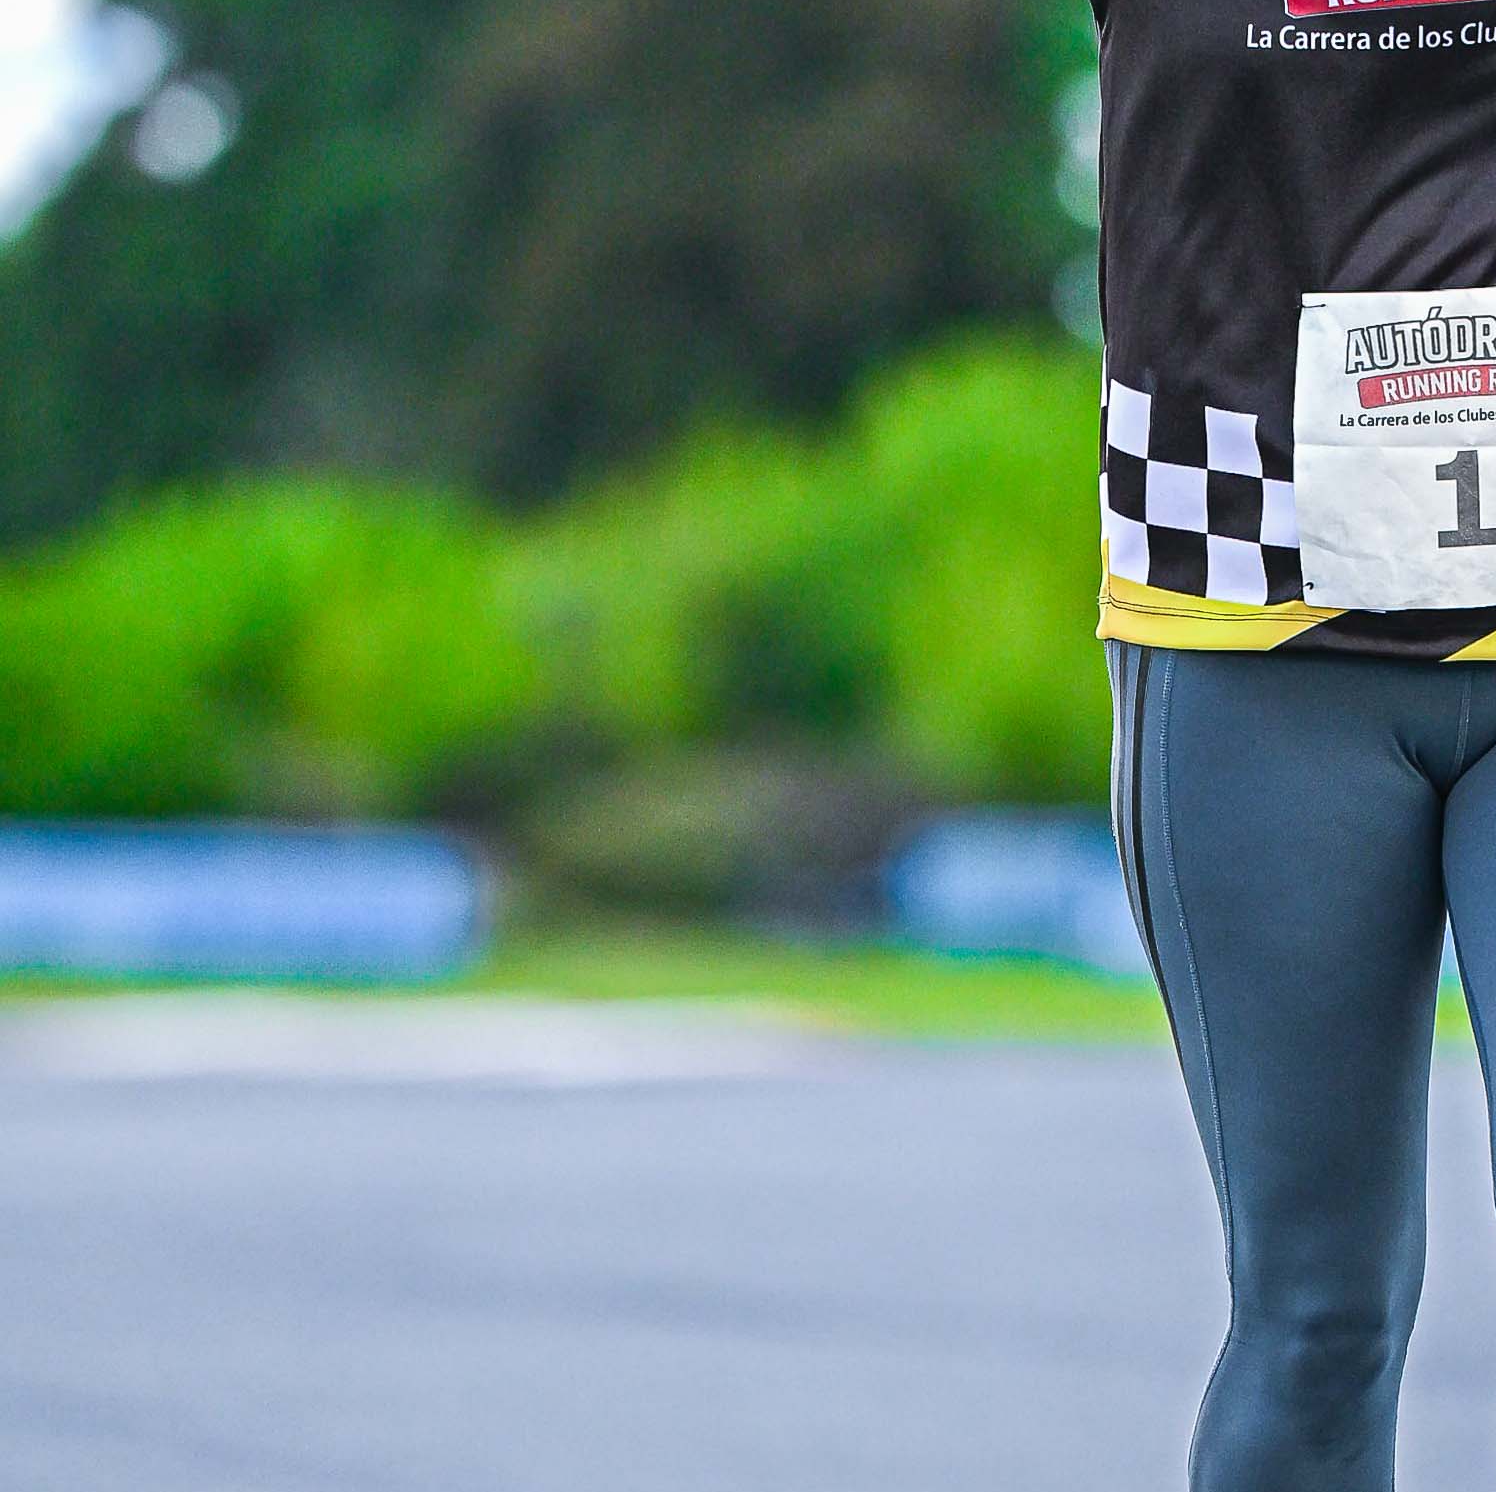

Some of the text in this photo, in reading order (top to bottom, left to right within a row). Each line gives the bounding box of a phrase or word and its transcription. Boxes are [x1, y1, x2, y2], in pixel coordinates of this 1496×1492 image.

[1246, 23, 1273, 49] La
[1279, 25, 1371, 50] Carrera
[1378, 26, 1412, 50] de
[1418, 25, 1454, 49] los
[1381, 369, 1482, 403] RUNNING
[1340, 414, 1355, 427] La
[1358, 413, 1409, 427] Carrera
[1413, 412, 1431, 425] de
[1434, 411, 1454, 424] los
